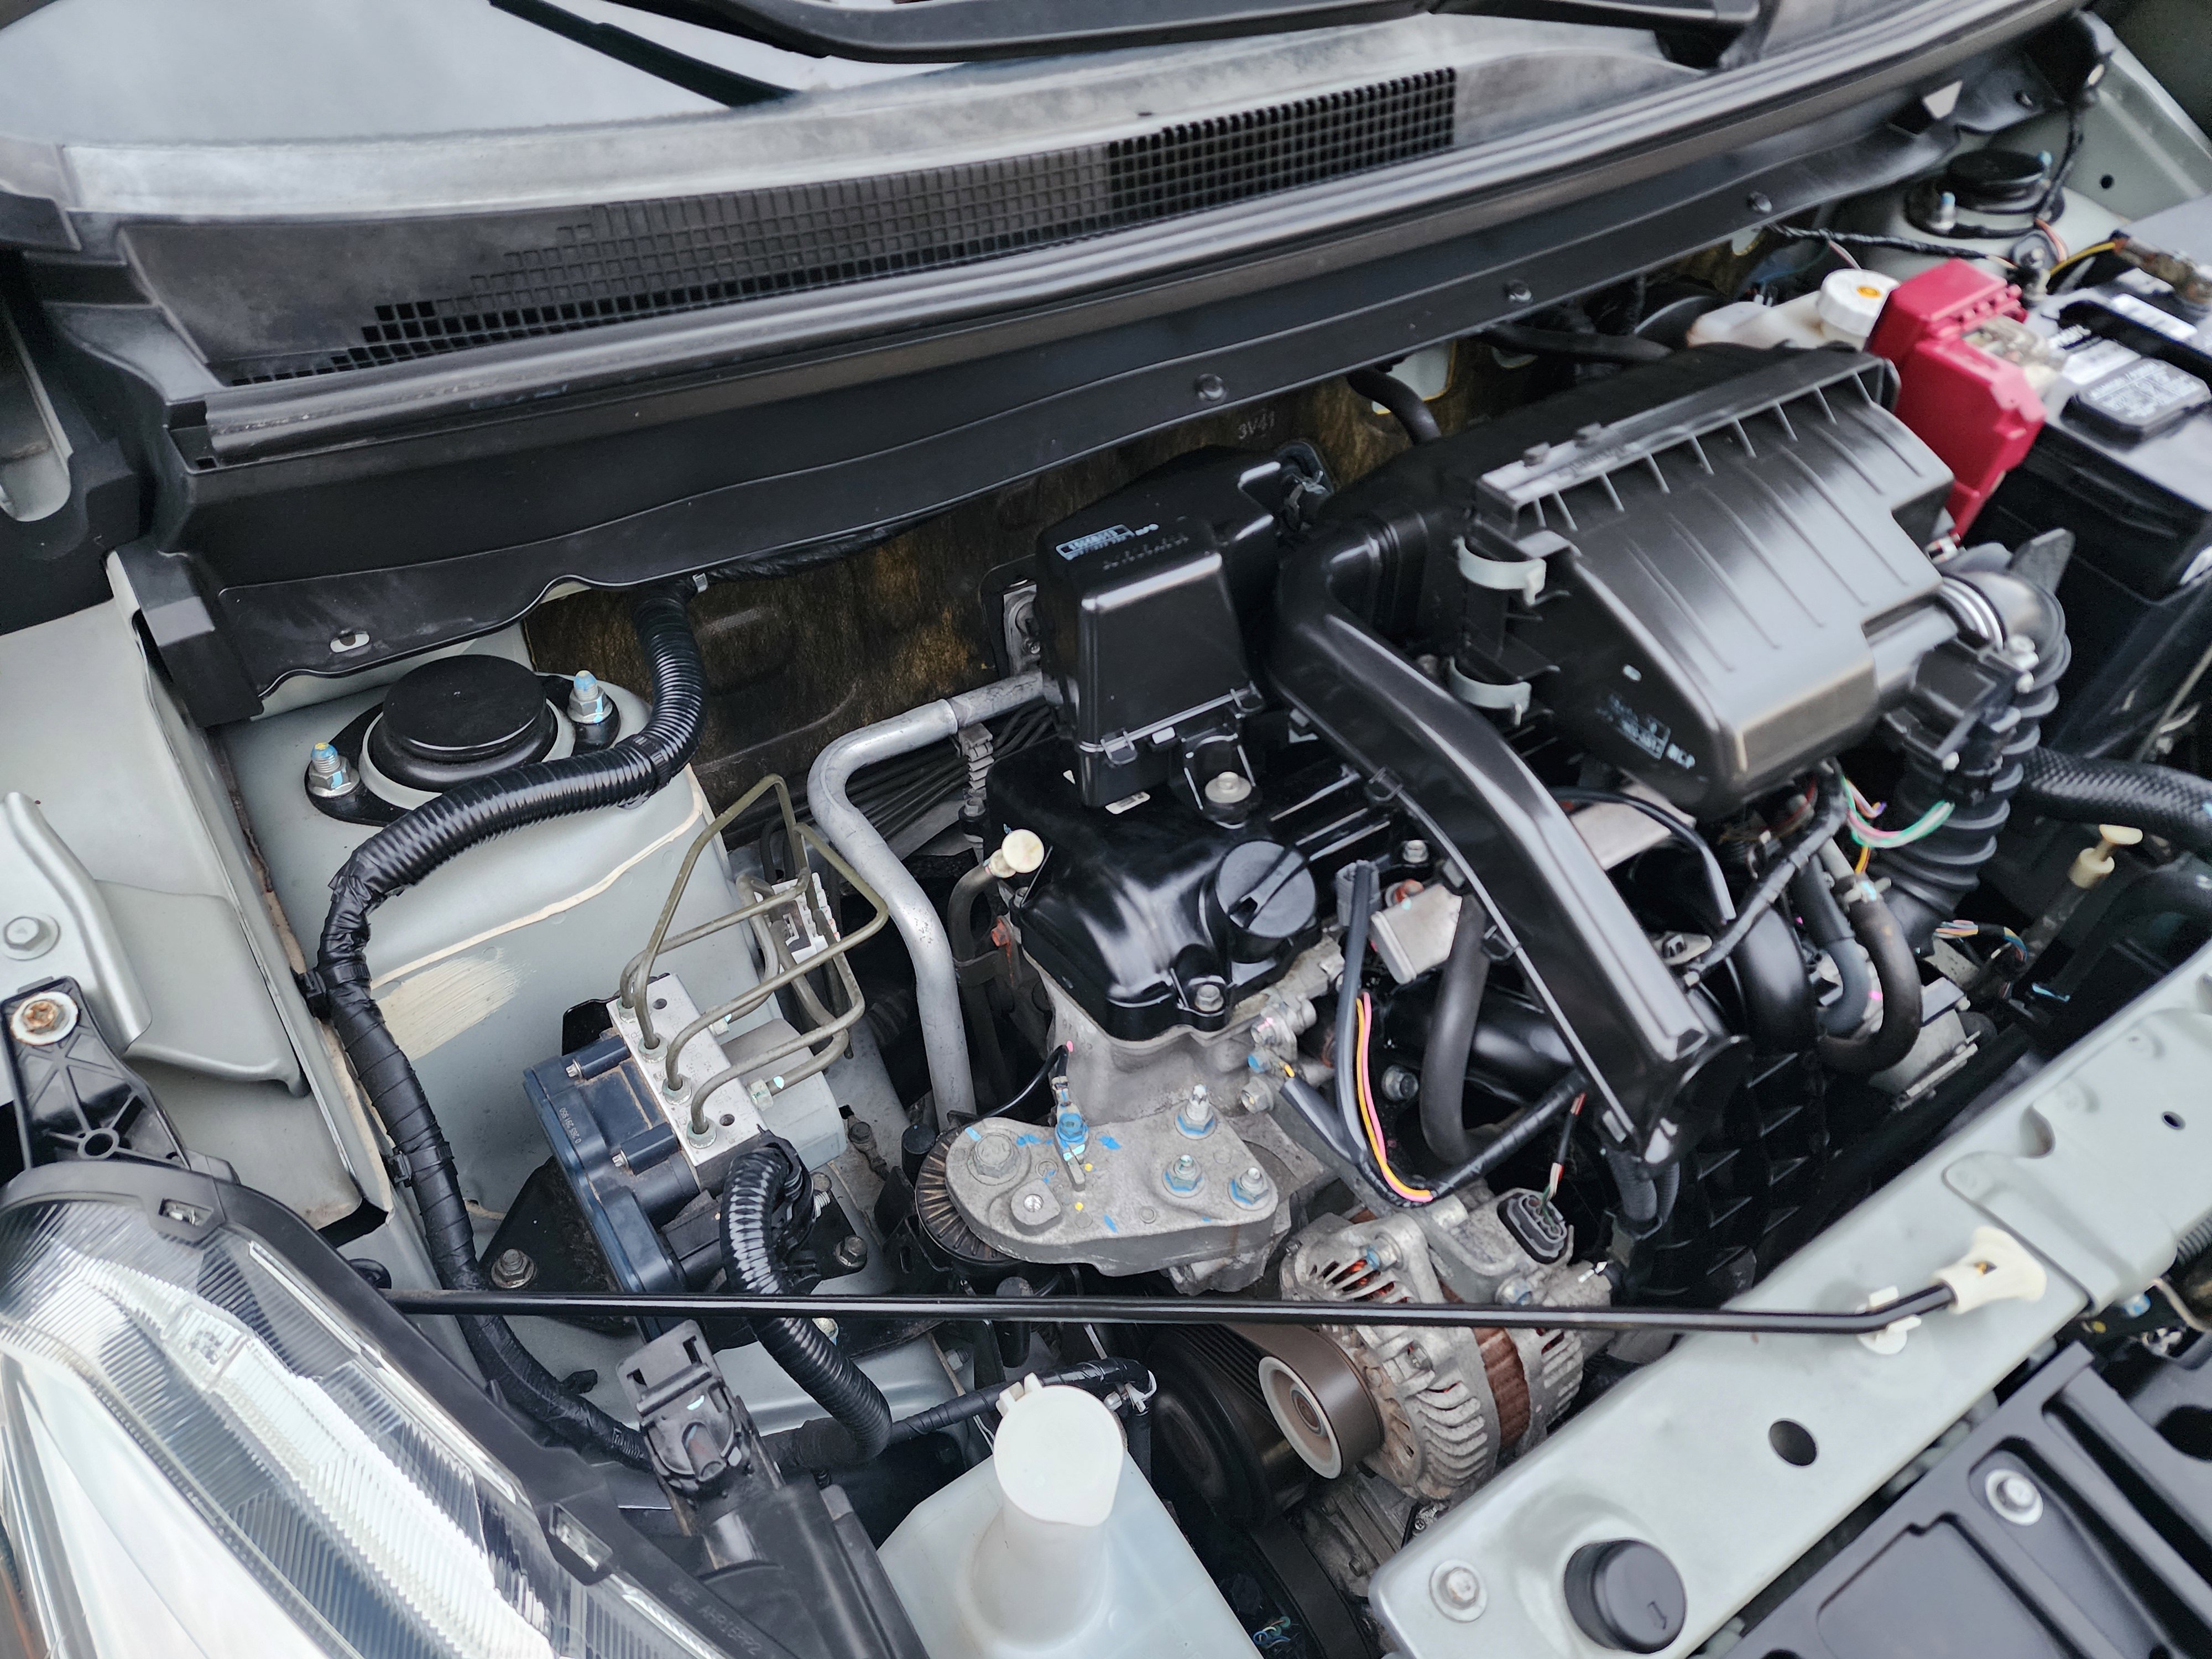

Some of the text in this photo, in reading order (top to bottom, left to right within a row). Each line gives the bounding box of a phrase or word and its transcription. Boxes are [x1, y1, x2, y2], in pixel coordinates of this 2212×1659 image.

[559, 1107, 568, 1119] 950
[565, 1118, 574, 1129] 291
[570, 1127, 580, 1139] 265
